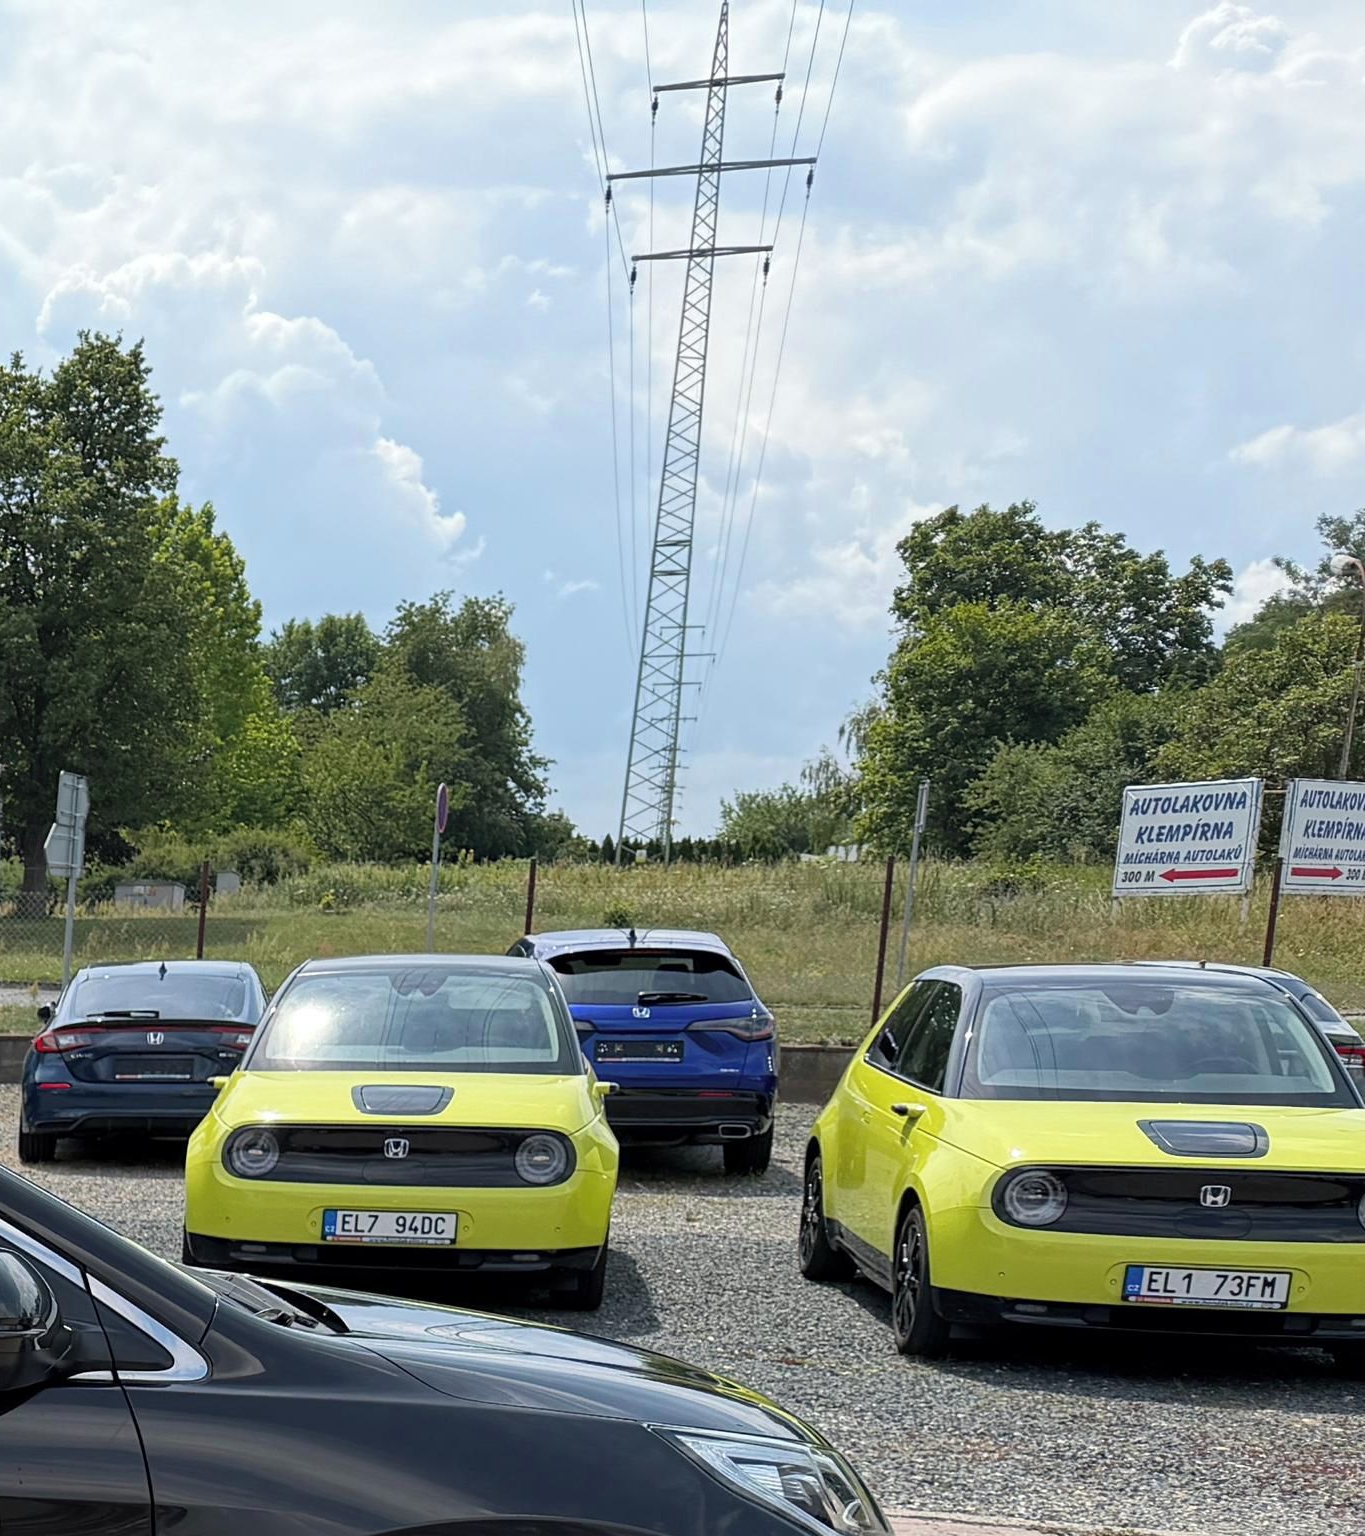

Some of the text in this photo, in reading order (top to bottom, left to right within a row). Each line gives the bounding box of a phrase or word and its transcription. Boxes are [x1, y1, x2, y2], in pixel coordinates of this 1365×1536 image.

[1129, 791, 1247, 816] AUTOLAKOVNA
[1134, 818, 1234, 845] KLEMPÍRNA
[1123, 844, 1244, 865] MÍCHÁRNA AUTOLAKŮ
[1121, 870, 1156, 883] 300 M
[341, 1213, 379, 1233] EL7
[395, 1215, 446, 1235] 94DC
[1127, 1271, 1277, 1299] CZ EL1 73FM
